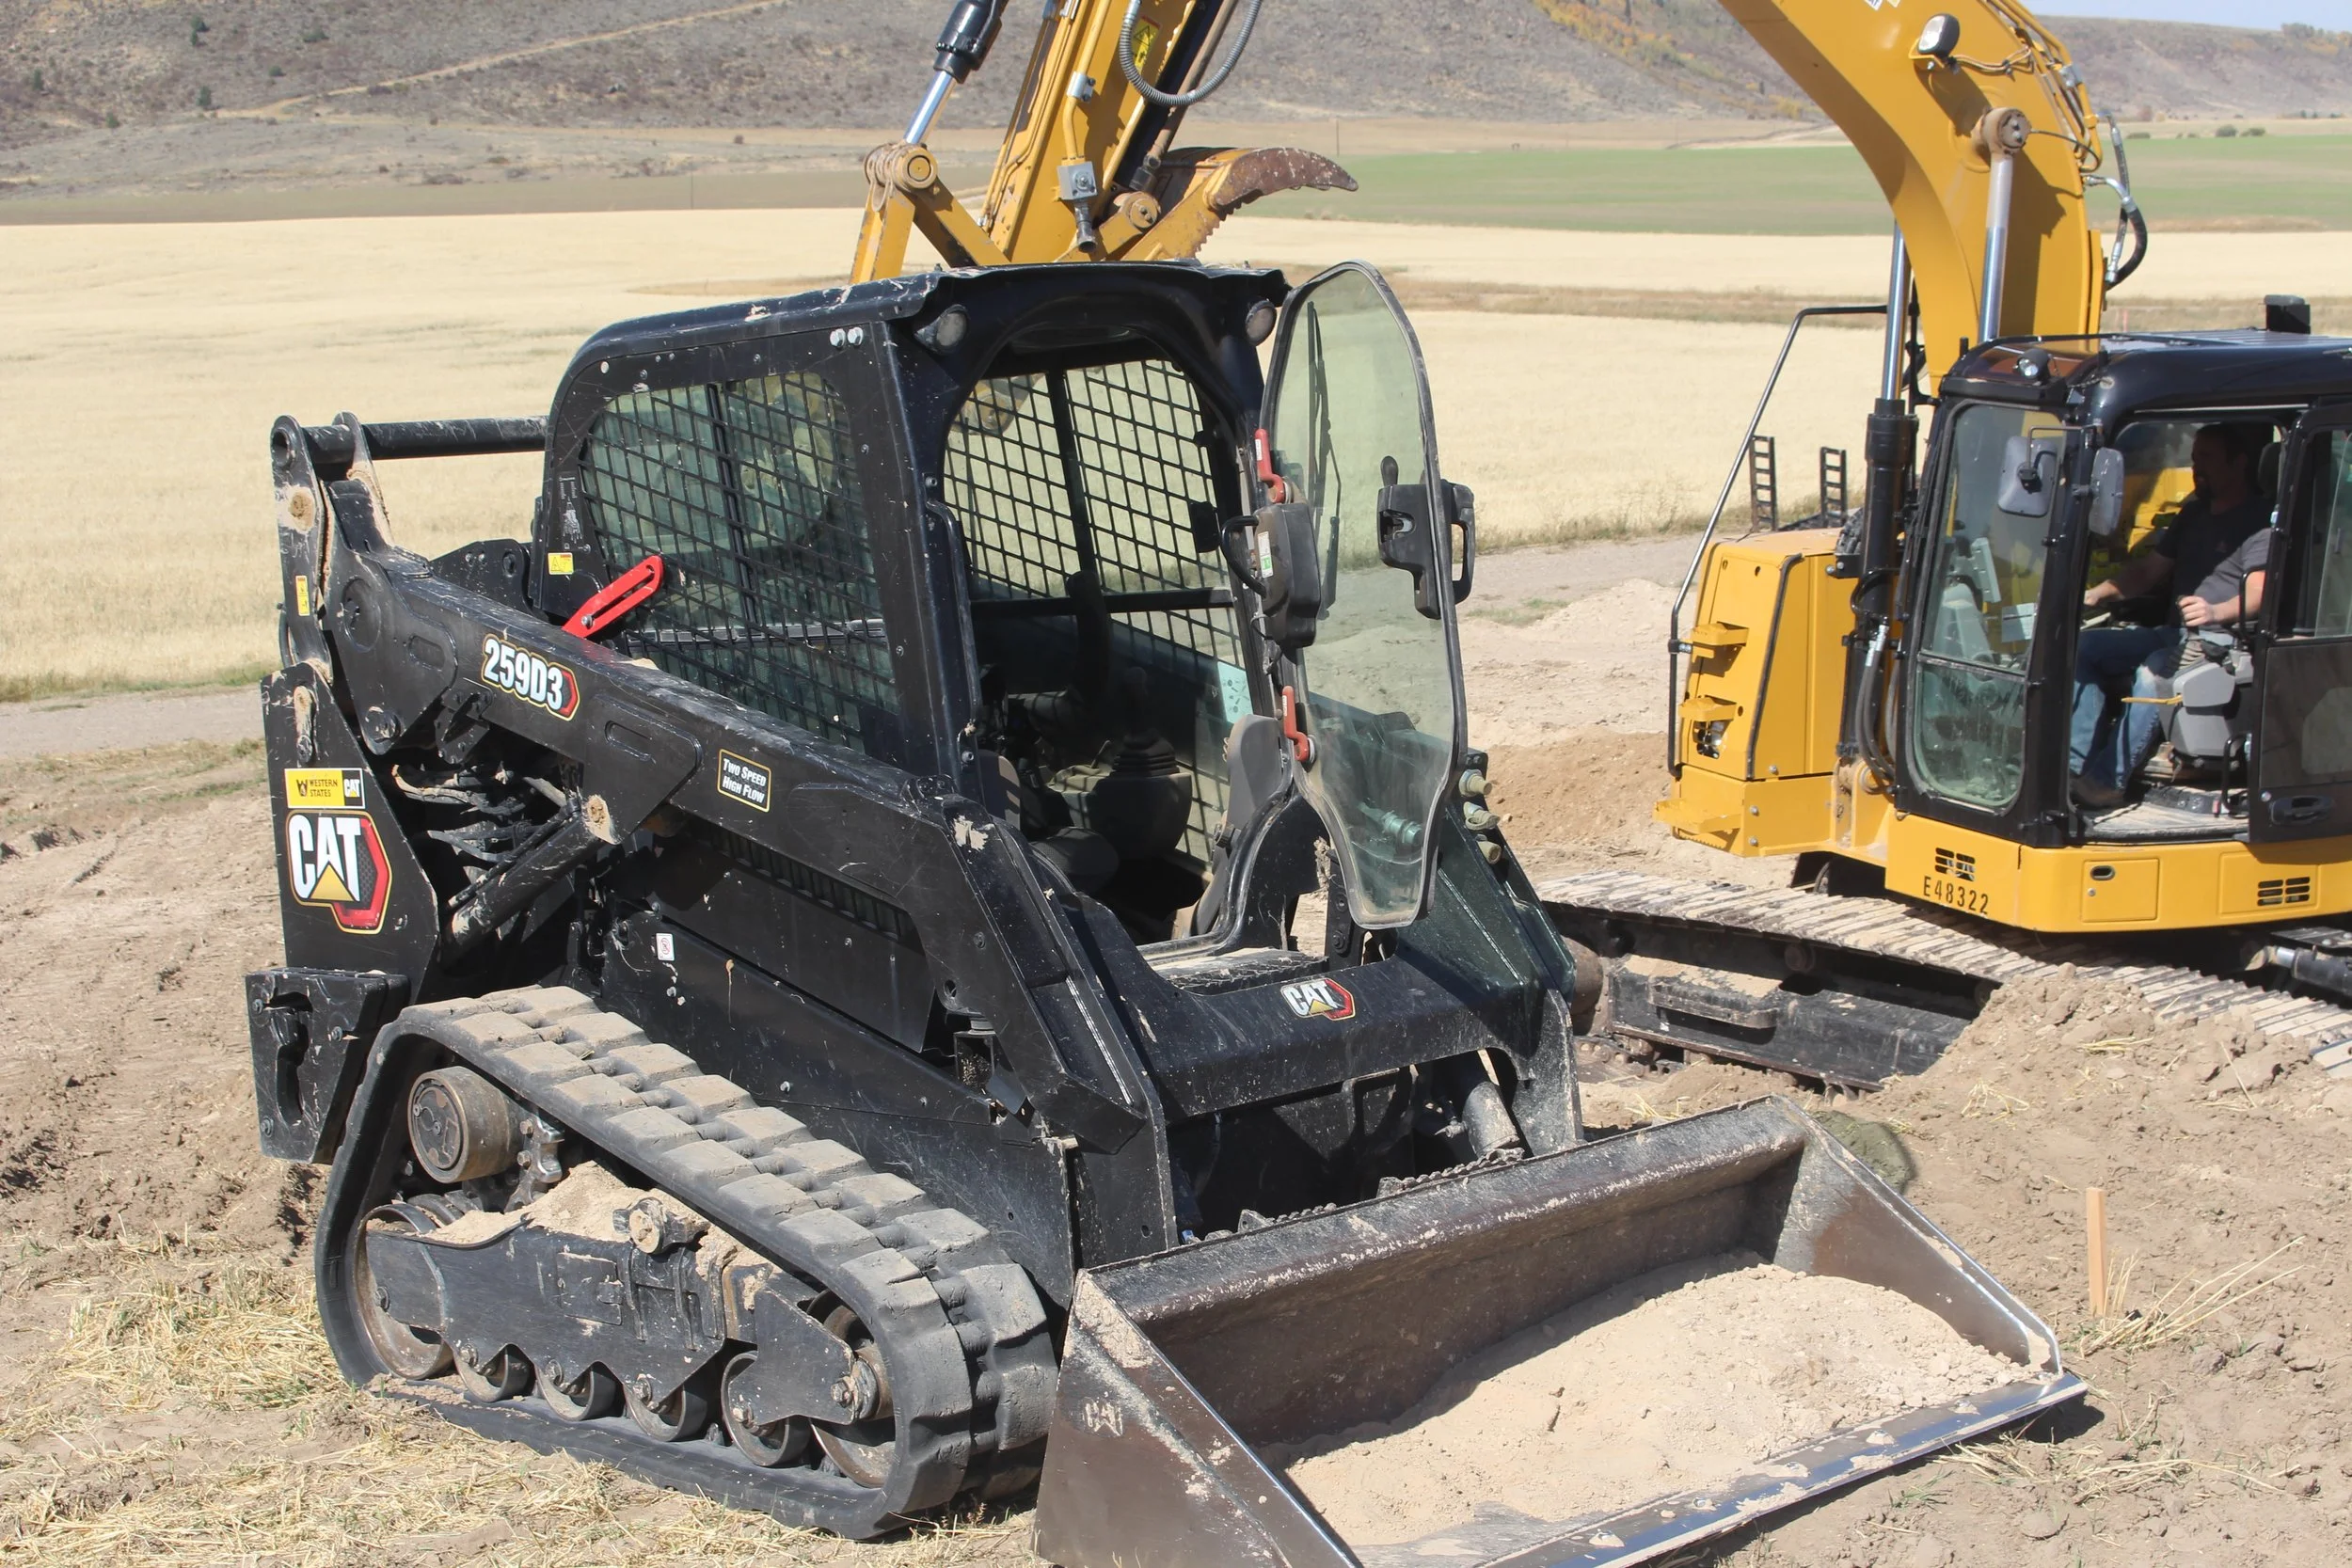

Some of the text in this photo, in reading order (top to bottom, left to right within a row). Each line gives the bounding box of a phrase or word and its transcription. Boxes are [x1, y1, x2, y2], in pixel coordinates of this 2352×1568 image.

[485, 639, 563, 710] 259D3
[309, 779, 338, 787] WESTERN
[343, 779, 360, 797] CAT
[723, 758, 767, 786] TWO SPEED
[722, 775, 765, 803] HIGH FLOW
[289, 815, 361, 901] CAT
[1923, 875, 1988, 914] E48322
[1282, 980, 1338, 1016] CAT
